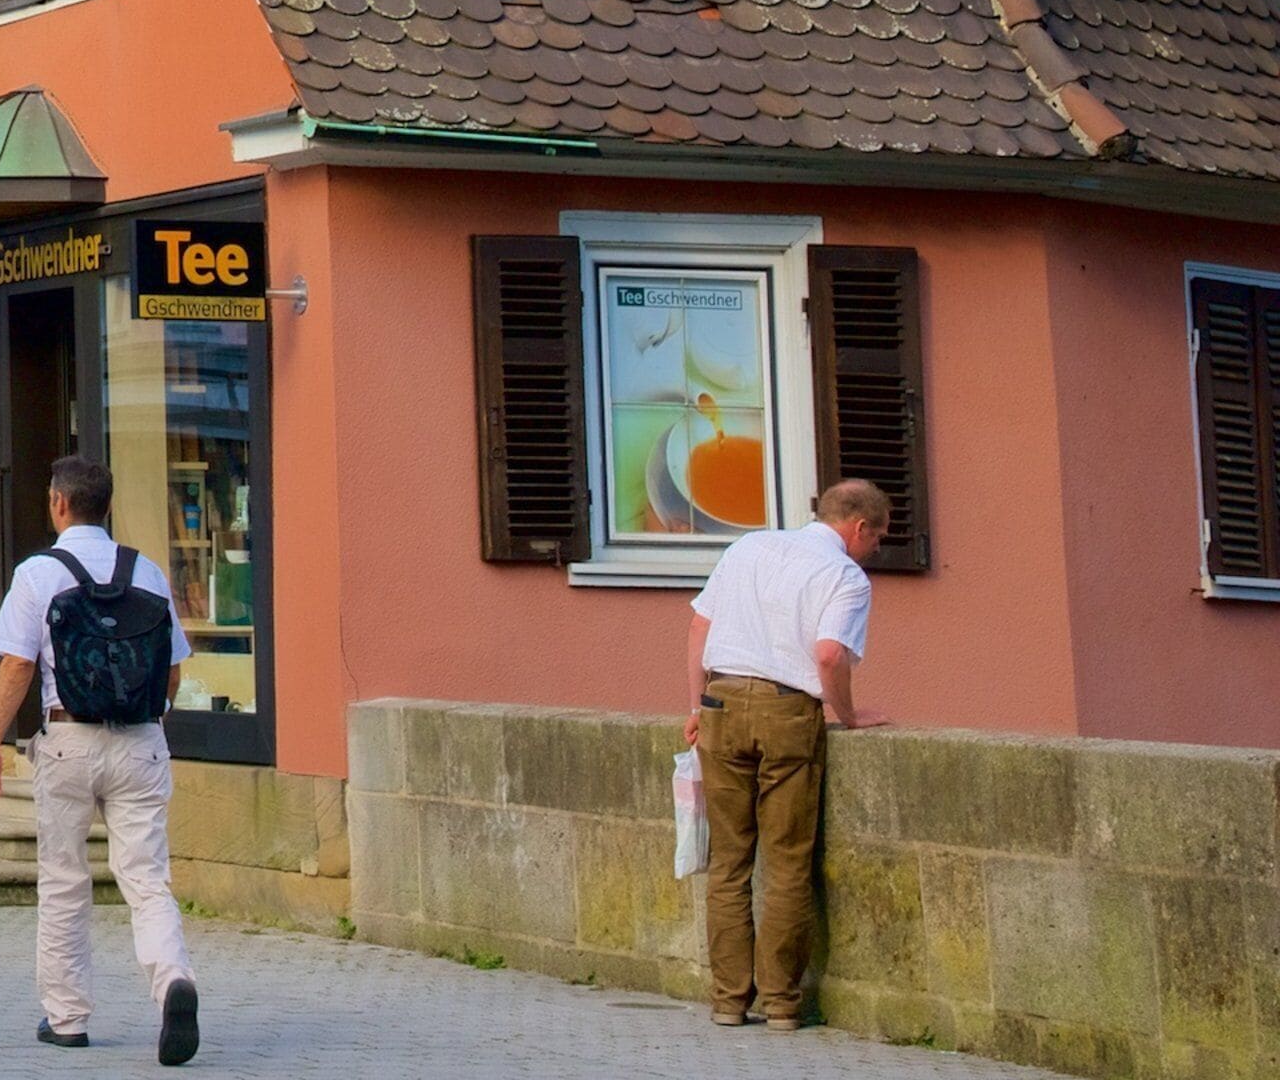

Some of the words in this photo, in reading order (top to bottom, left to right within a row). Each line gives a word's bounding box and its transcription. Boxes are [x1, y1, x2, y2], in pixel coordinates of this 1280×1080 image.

[154, 230, 249, 286] Tee
[145, 298, 260, 319] Gschwendner
[618, 289, 643, 305] Tee
[646, 290, 739, 308] Gschwendner
